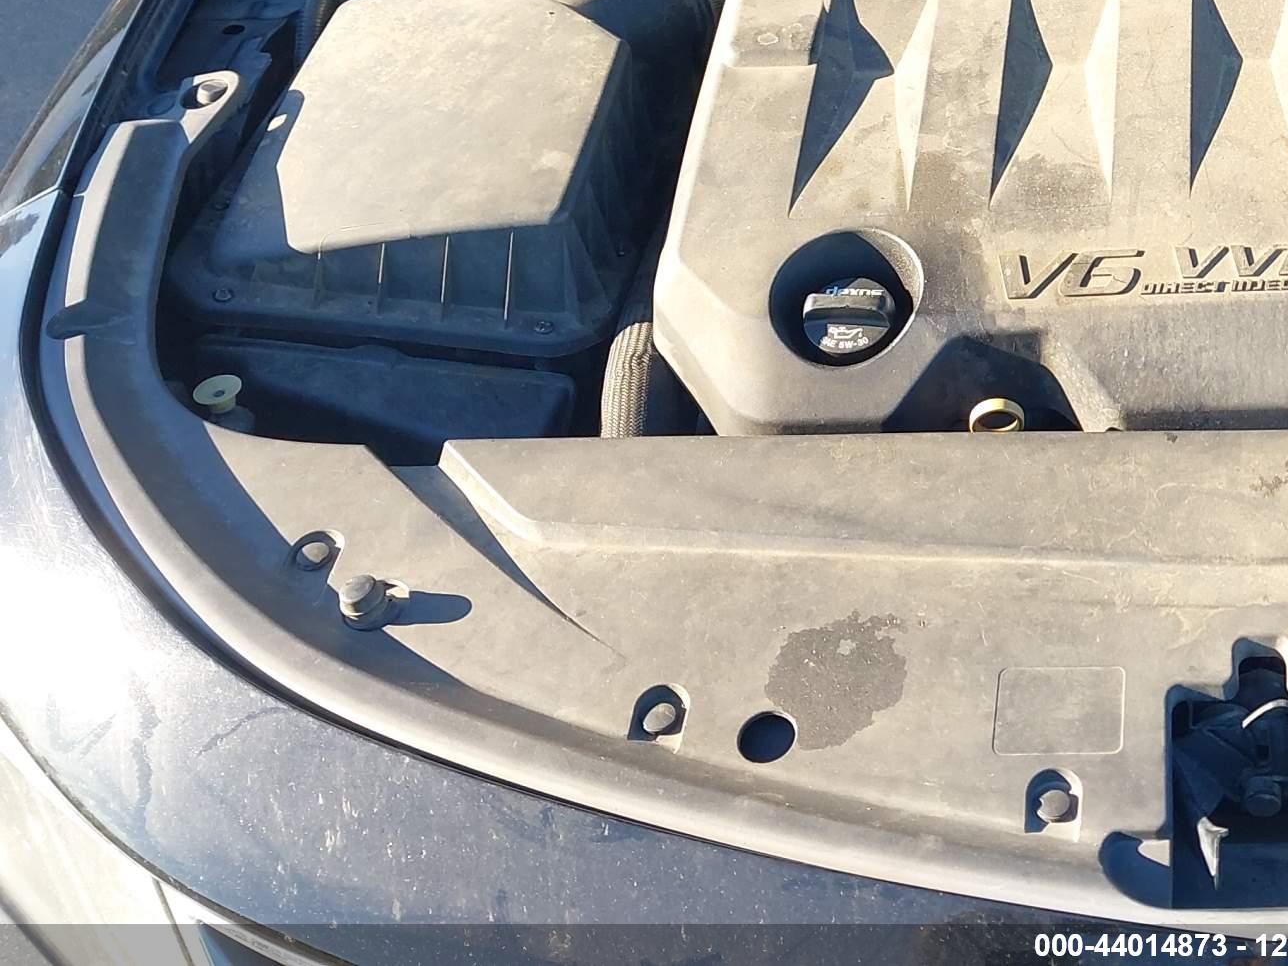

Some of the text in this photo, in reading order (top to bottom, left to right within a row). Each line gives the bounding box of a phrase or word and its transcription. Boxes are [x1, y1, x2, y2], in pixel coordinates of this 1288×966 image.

[999, 249, 1145, 299] V6
[1141, 280, 1229, 295] DIRECT
[838, 336, 869, 349] 5W-30
